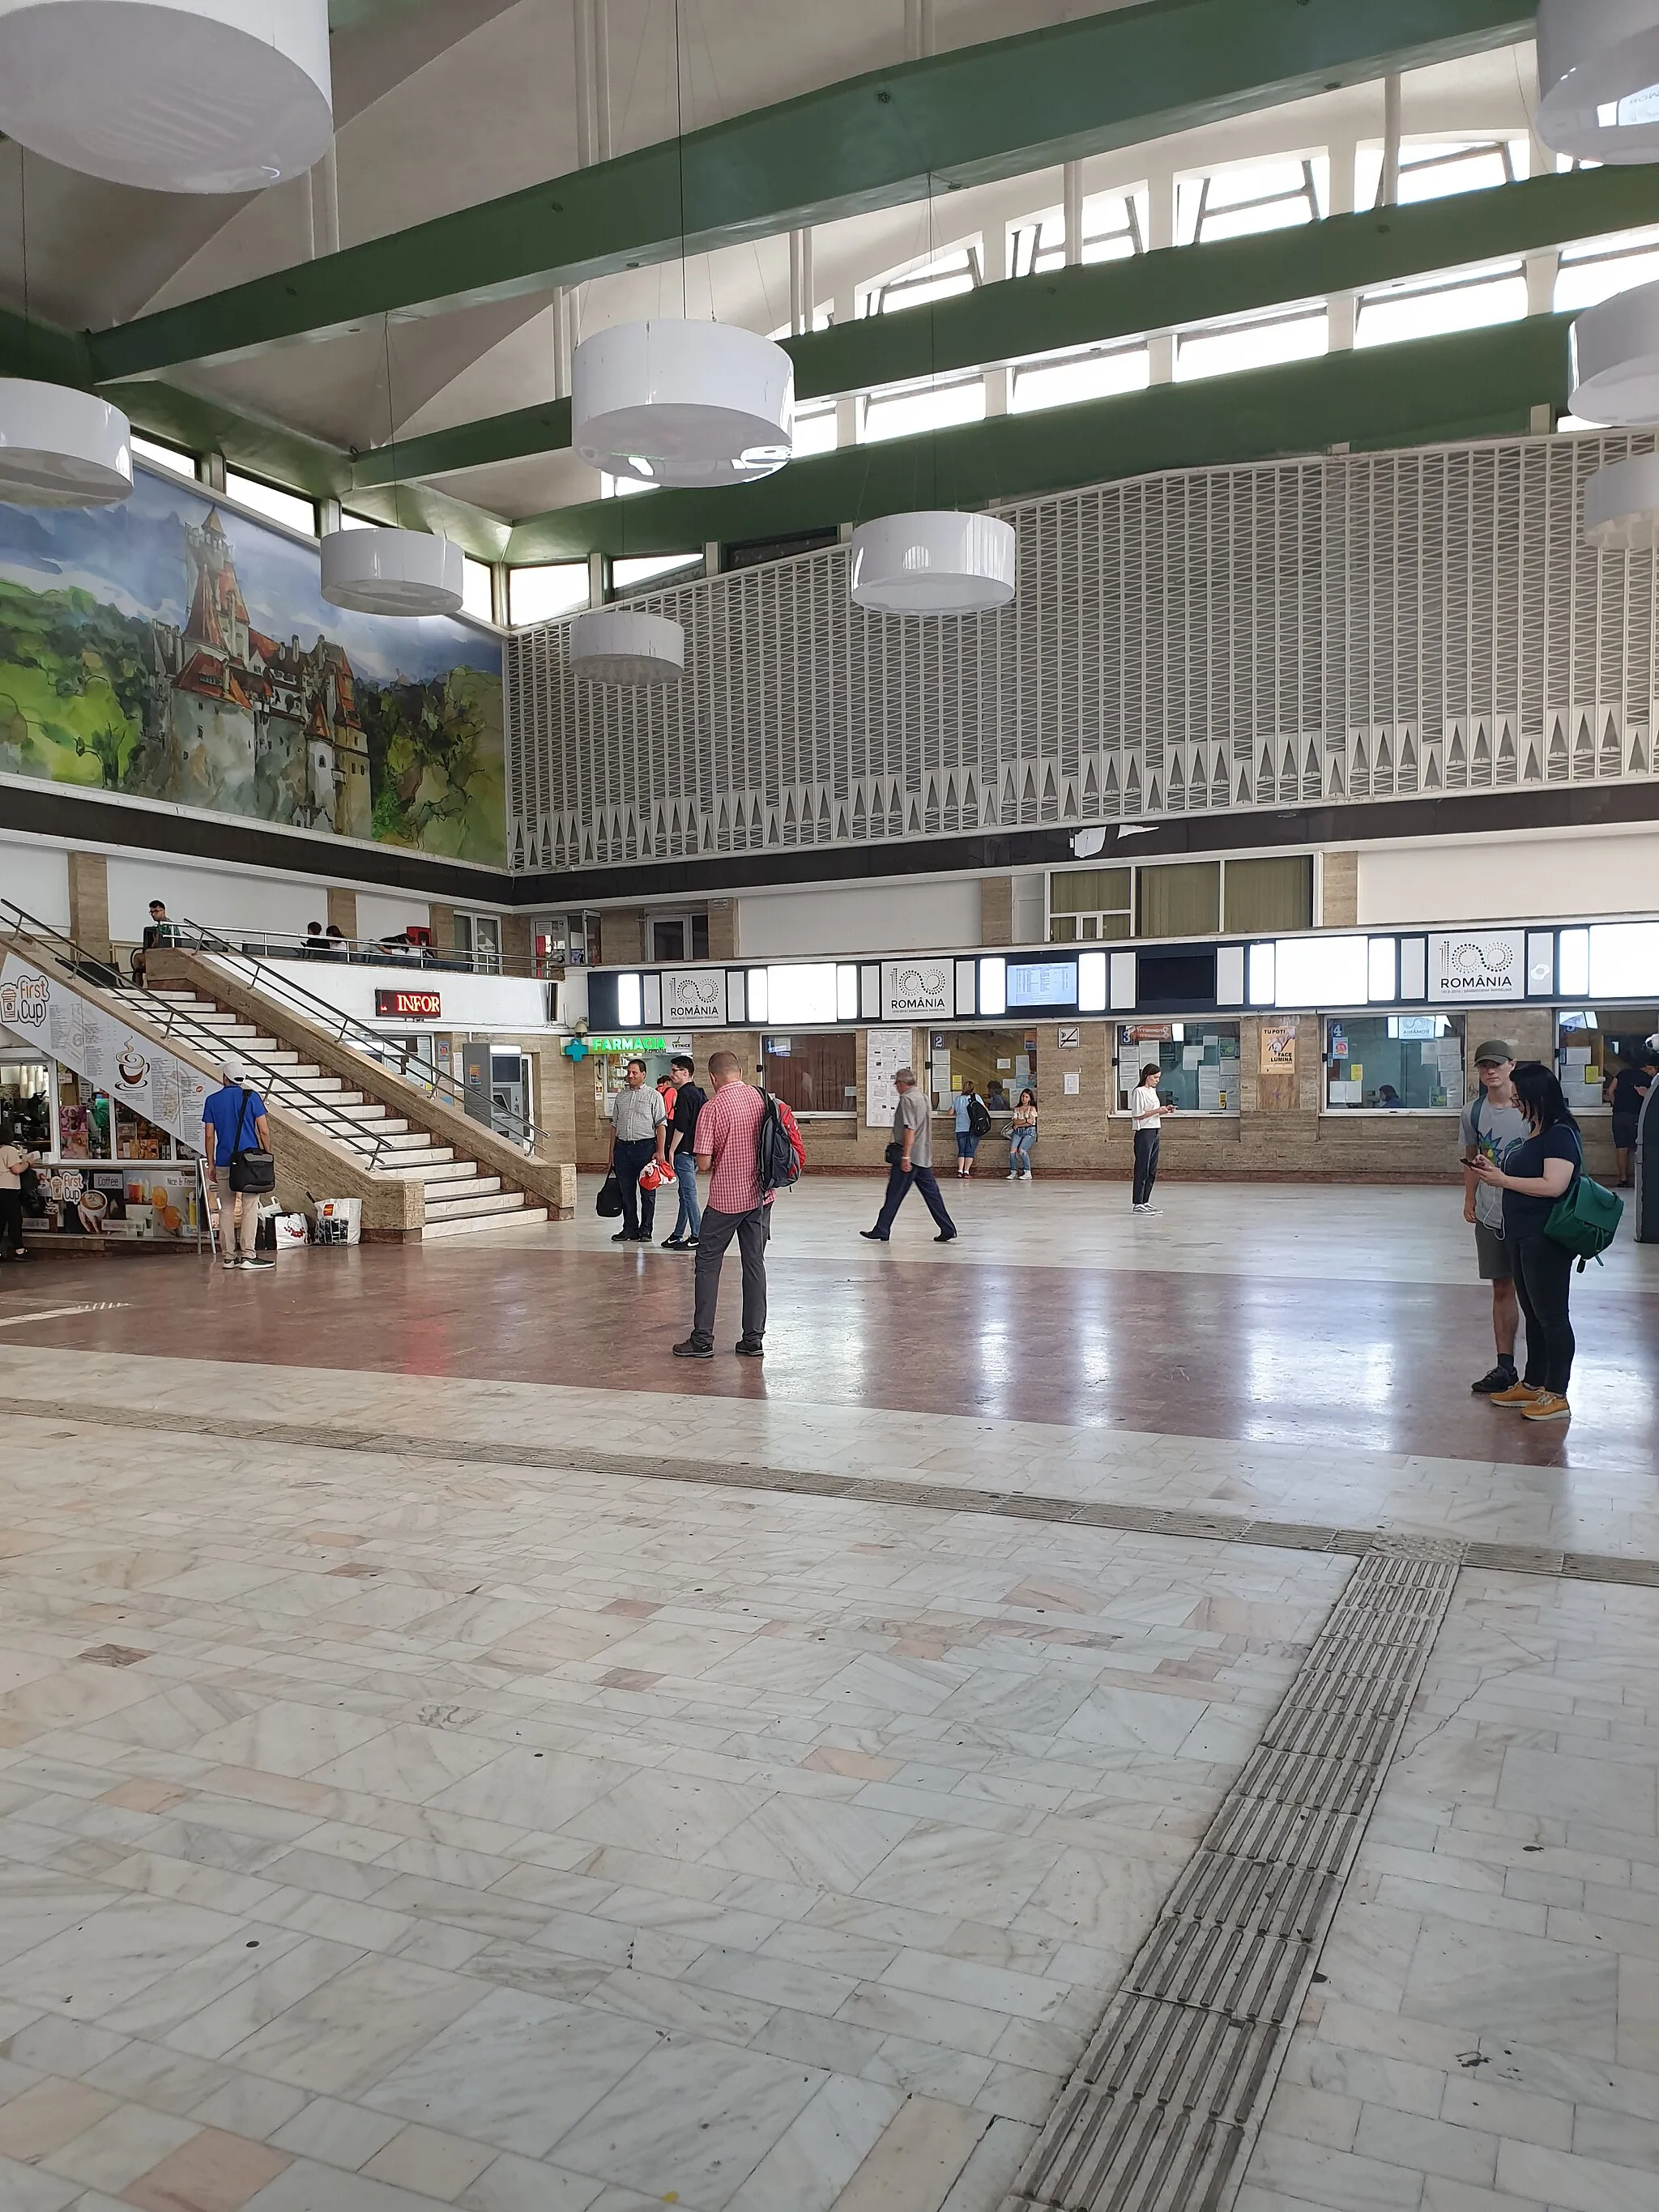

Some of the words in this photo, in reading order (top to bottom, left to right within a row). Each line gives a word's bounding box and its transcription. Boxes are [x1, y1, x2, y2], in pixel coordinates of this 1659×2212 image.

[1440, 974, 1512, 988] ROMÂNIA
[20, 980, 47, 999] First
[397, 995, 440, 1012] INFOR
[891, 997, 945, 1009] ROMÂNIA
[21, 999, 44, 1023] Cup
[671, 1004, 719, 1016] ROMÂNIA
[1333, 1024, 1342, 1037] 4
[593, 1037, 667, 1051] FARMACIA
[935, 1035, 943, 1048] 2
[64, 1174, 82, 1187] First
[98, 1177, 119, 1187] Coffee
[167, 1178, 177, 1186] Nice
[65, 1187, 80, 1202] Cup
